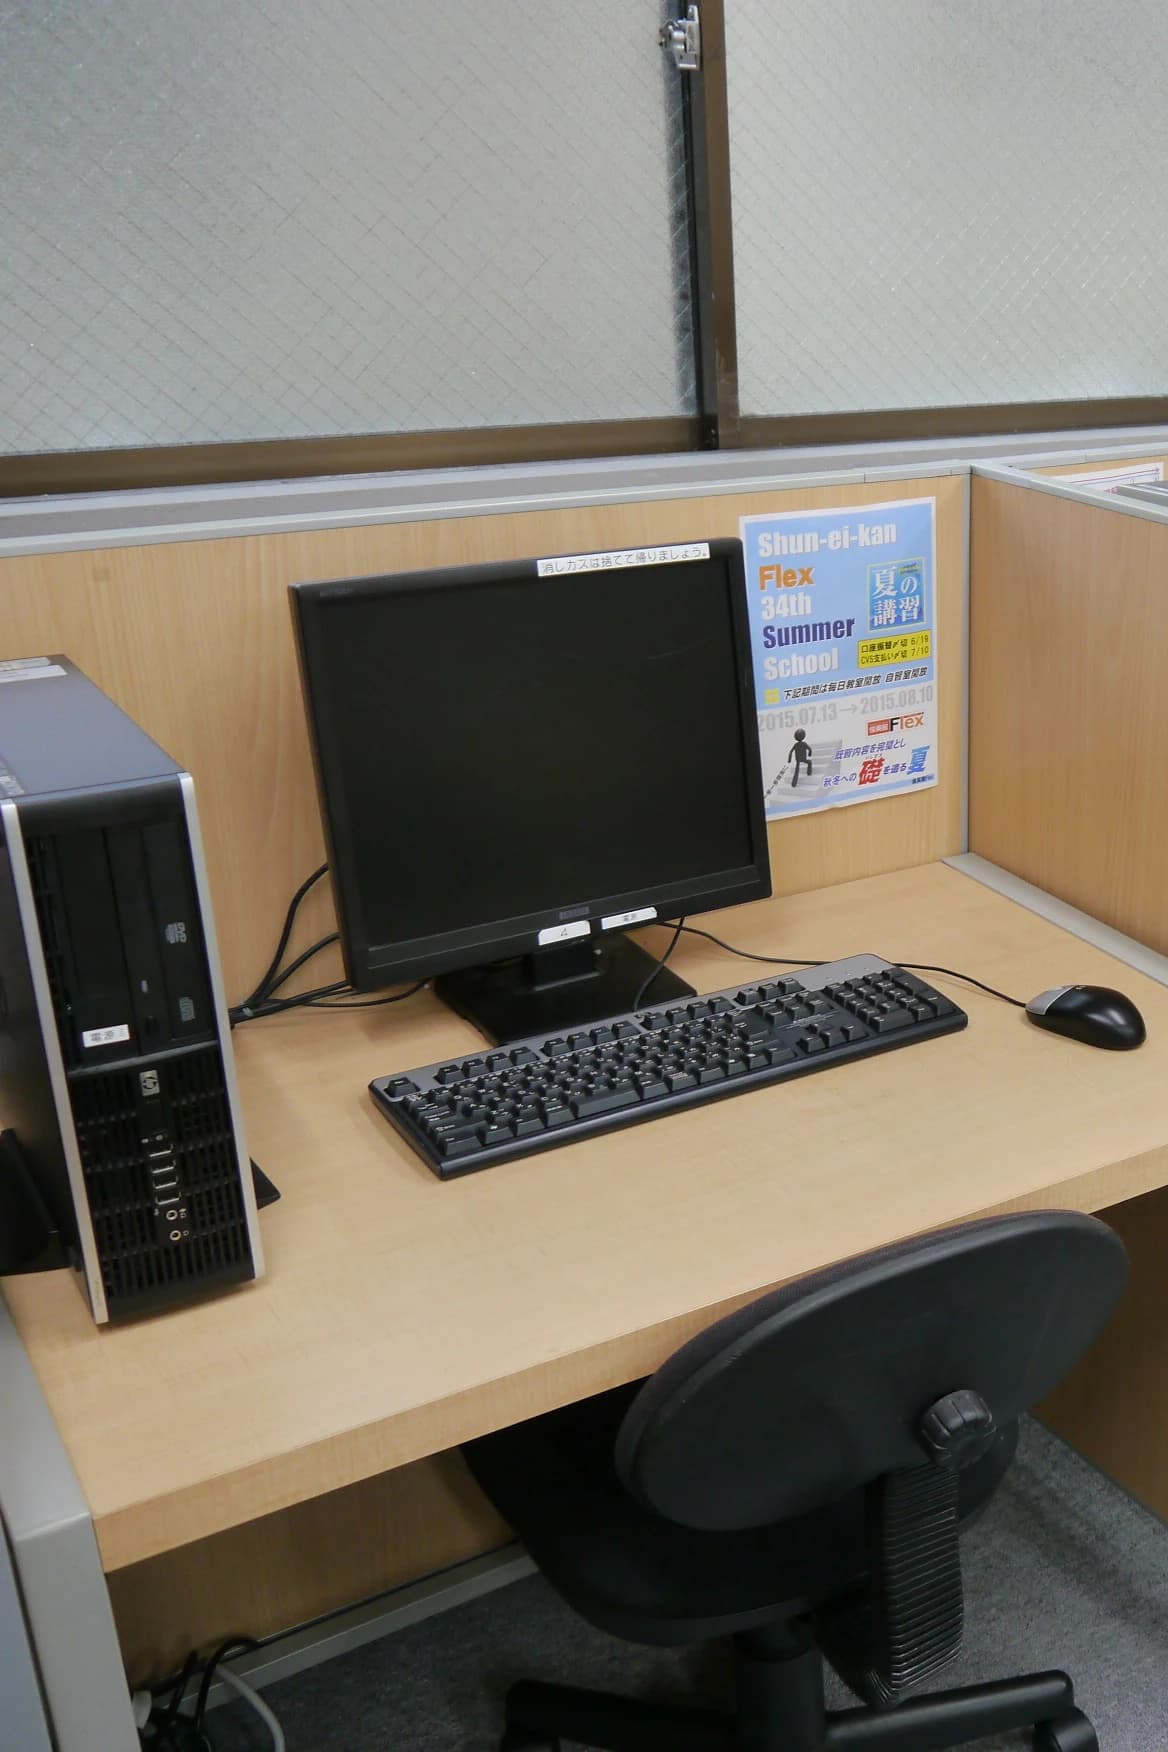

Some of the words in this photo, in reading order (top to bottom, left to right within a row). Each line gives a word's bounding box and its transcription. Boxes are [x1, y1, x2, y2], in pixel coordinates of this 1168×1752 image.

[758, 523, 897, 558] Shun-ei-kan
[759, 564, 815, 591] Flex
[872, 566, 919, 599] 夏の
[761, 592, 813, 621] 34th
[873, 595, 920, 626] 講習
[763, 617, 855, 649] Summer
[764, 648, 839, 682] School
[861, 685, 934, 715] 2015.08.10
[890, 712, 925, 732] Flex
